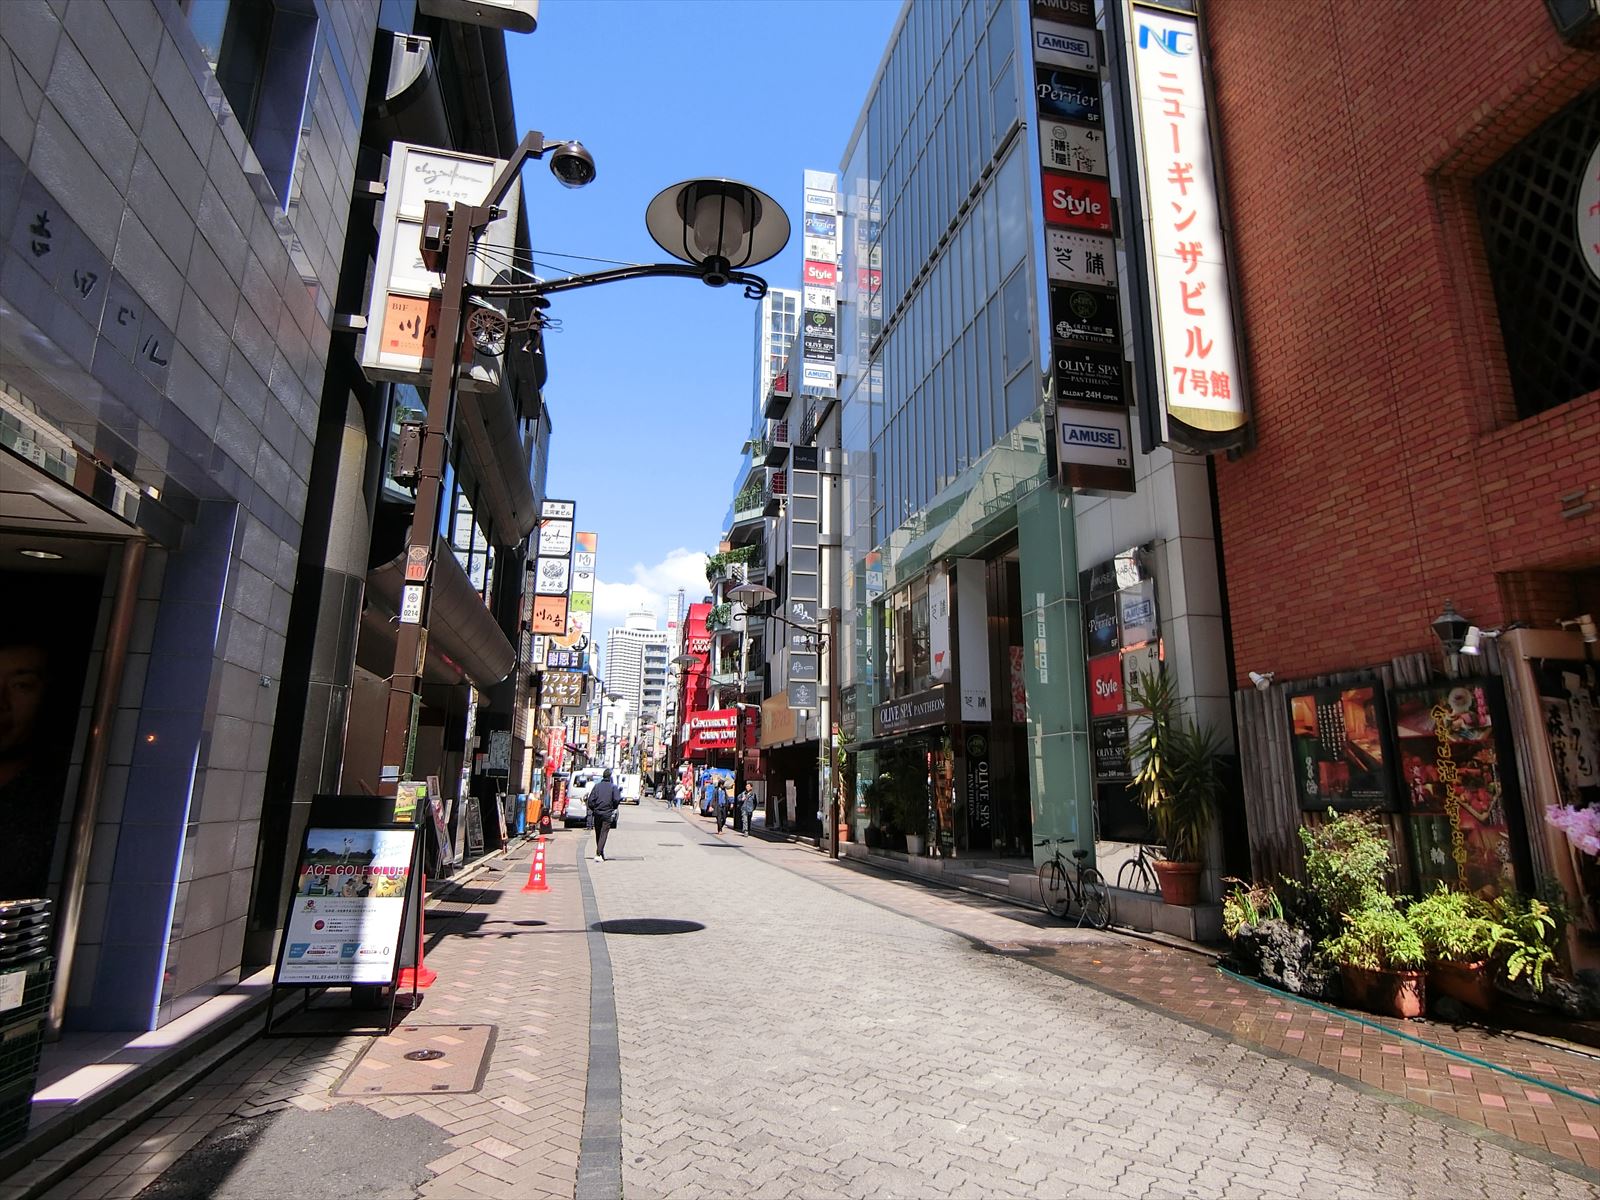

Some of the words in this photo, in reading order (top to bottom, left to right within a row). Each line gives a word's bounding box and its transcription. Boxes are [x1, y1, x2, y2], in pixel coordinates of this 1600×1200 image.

[1036, 0, 1089, 15] AMUSE
[1042, 37, 1086, 53] AMUSE
[1037, 83, 1099, 107] Perrier
[1087, 113, 1100, 121] 5F
[1086, 131, 1101, 142] 4F
[1053, 188, 1102, 215] Style
[1157, 71, 1214, 359] ニューギンザビル
[1053, 247, 1105, 276] 芝浦
[808, 267, 833, 280] Style
[807, 371, 830, 379] AMUSE
[1058, 359, 1095, 374] OLIVE
[1098, 364, 1120, 377] SPA
[1172, 365, 1233, 400] 7号館
[1062, 390, 1084, 398] ALLDAY
[1085, 390, 1102, 399] 24H
[1069, 429, 1116, 444] AMUSE
[411, 566, 423, 578] 10
[403, 609, 419, 617] 0214
[1110, 638, 1118, 647] 5F
[1147, 647, 1159, 660] 4F
[541, 672, 580, 683] カラオケ
[540, 683, 580, 695] パセラ
[1095, 678, 1118, 697] Style
[880, 705, 900, 723] OLIVE
[900, 701, 913, 718] SPA
[913, 697, 945, 715] PANTHEON
[978, 761, 990, 801] OLIVE
[980, 804, 991, 828] SPA
[305, 864, 332, 876] ACE
[335, 864, 371, 876] GOLF
[372, 865, 407, 877] CLUB
